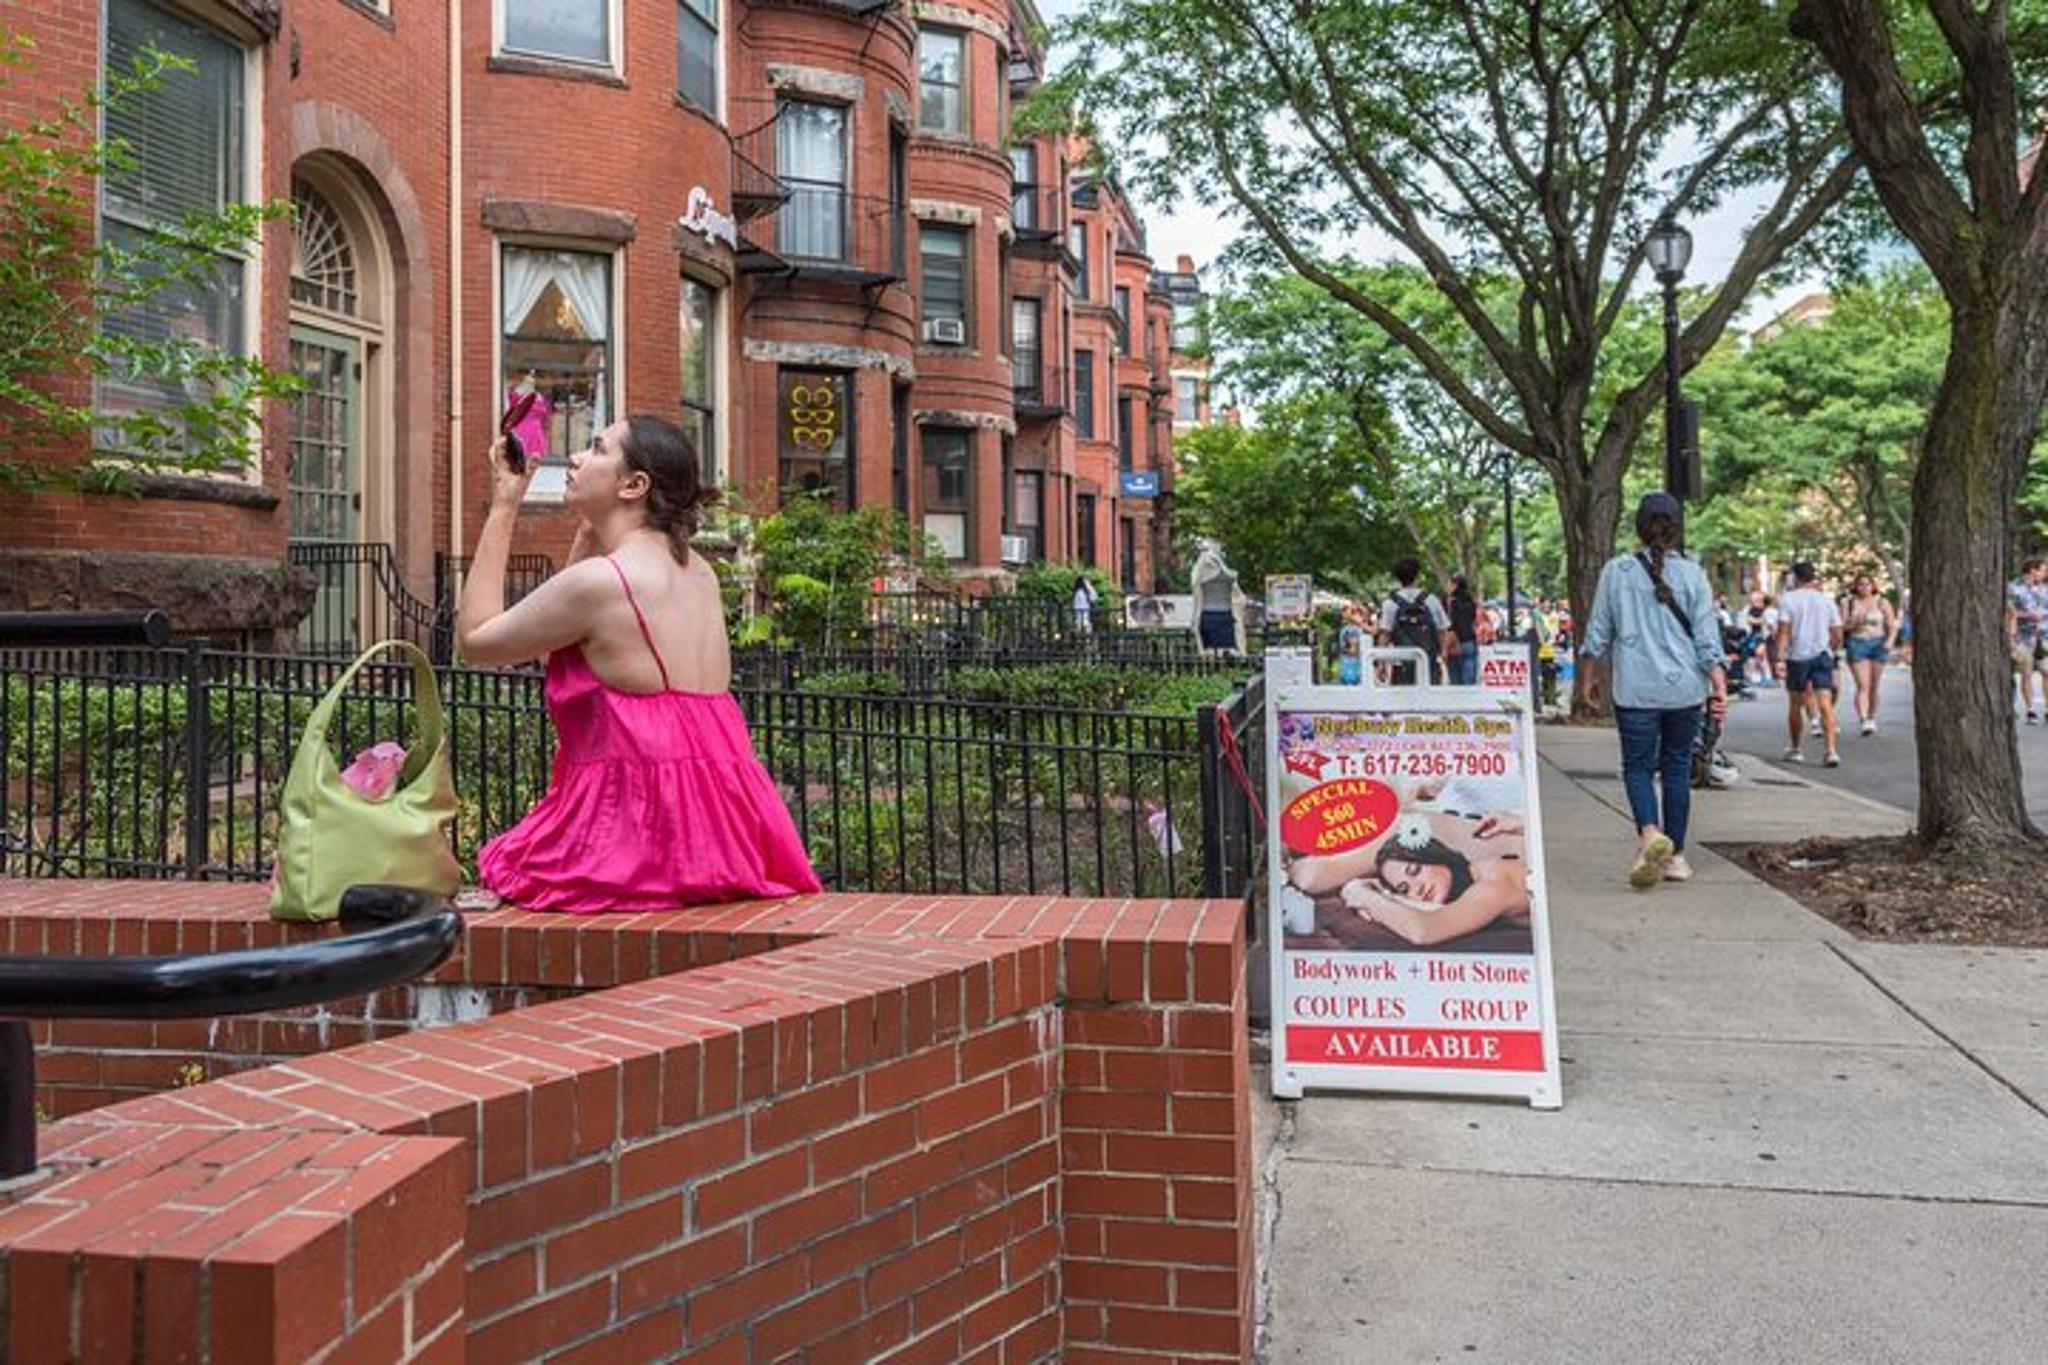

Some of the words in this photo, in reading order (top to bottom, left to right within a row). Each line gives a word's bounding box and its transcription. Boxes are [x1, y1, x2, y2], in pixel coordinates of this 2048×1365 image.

[1484, 659, 1528, 675] ATM
[1473, 715, 1512, 737] Spa
[1337, 755, 1357, 775] T:
[1363, 754, 1506, 776] 617-236-7900
[1290, 781, 1374, 820] SPECIAL
[1321, 801, 1356, 826] $60
[1315, 813, 1379, 849] 45MIN
[1293, 958, 1396, 985] Bodywork
[1428, 961, 1466, 982] Hot
[1472, 961, 1531, 984] Stone
[1293, 995, 1406, 1019] COUPLES
[1440, 998, 1529, 1022] GROUP
[1324, 1033, 1502, 1060] AVAILABLE
